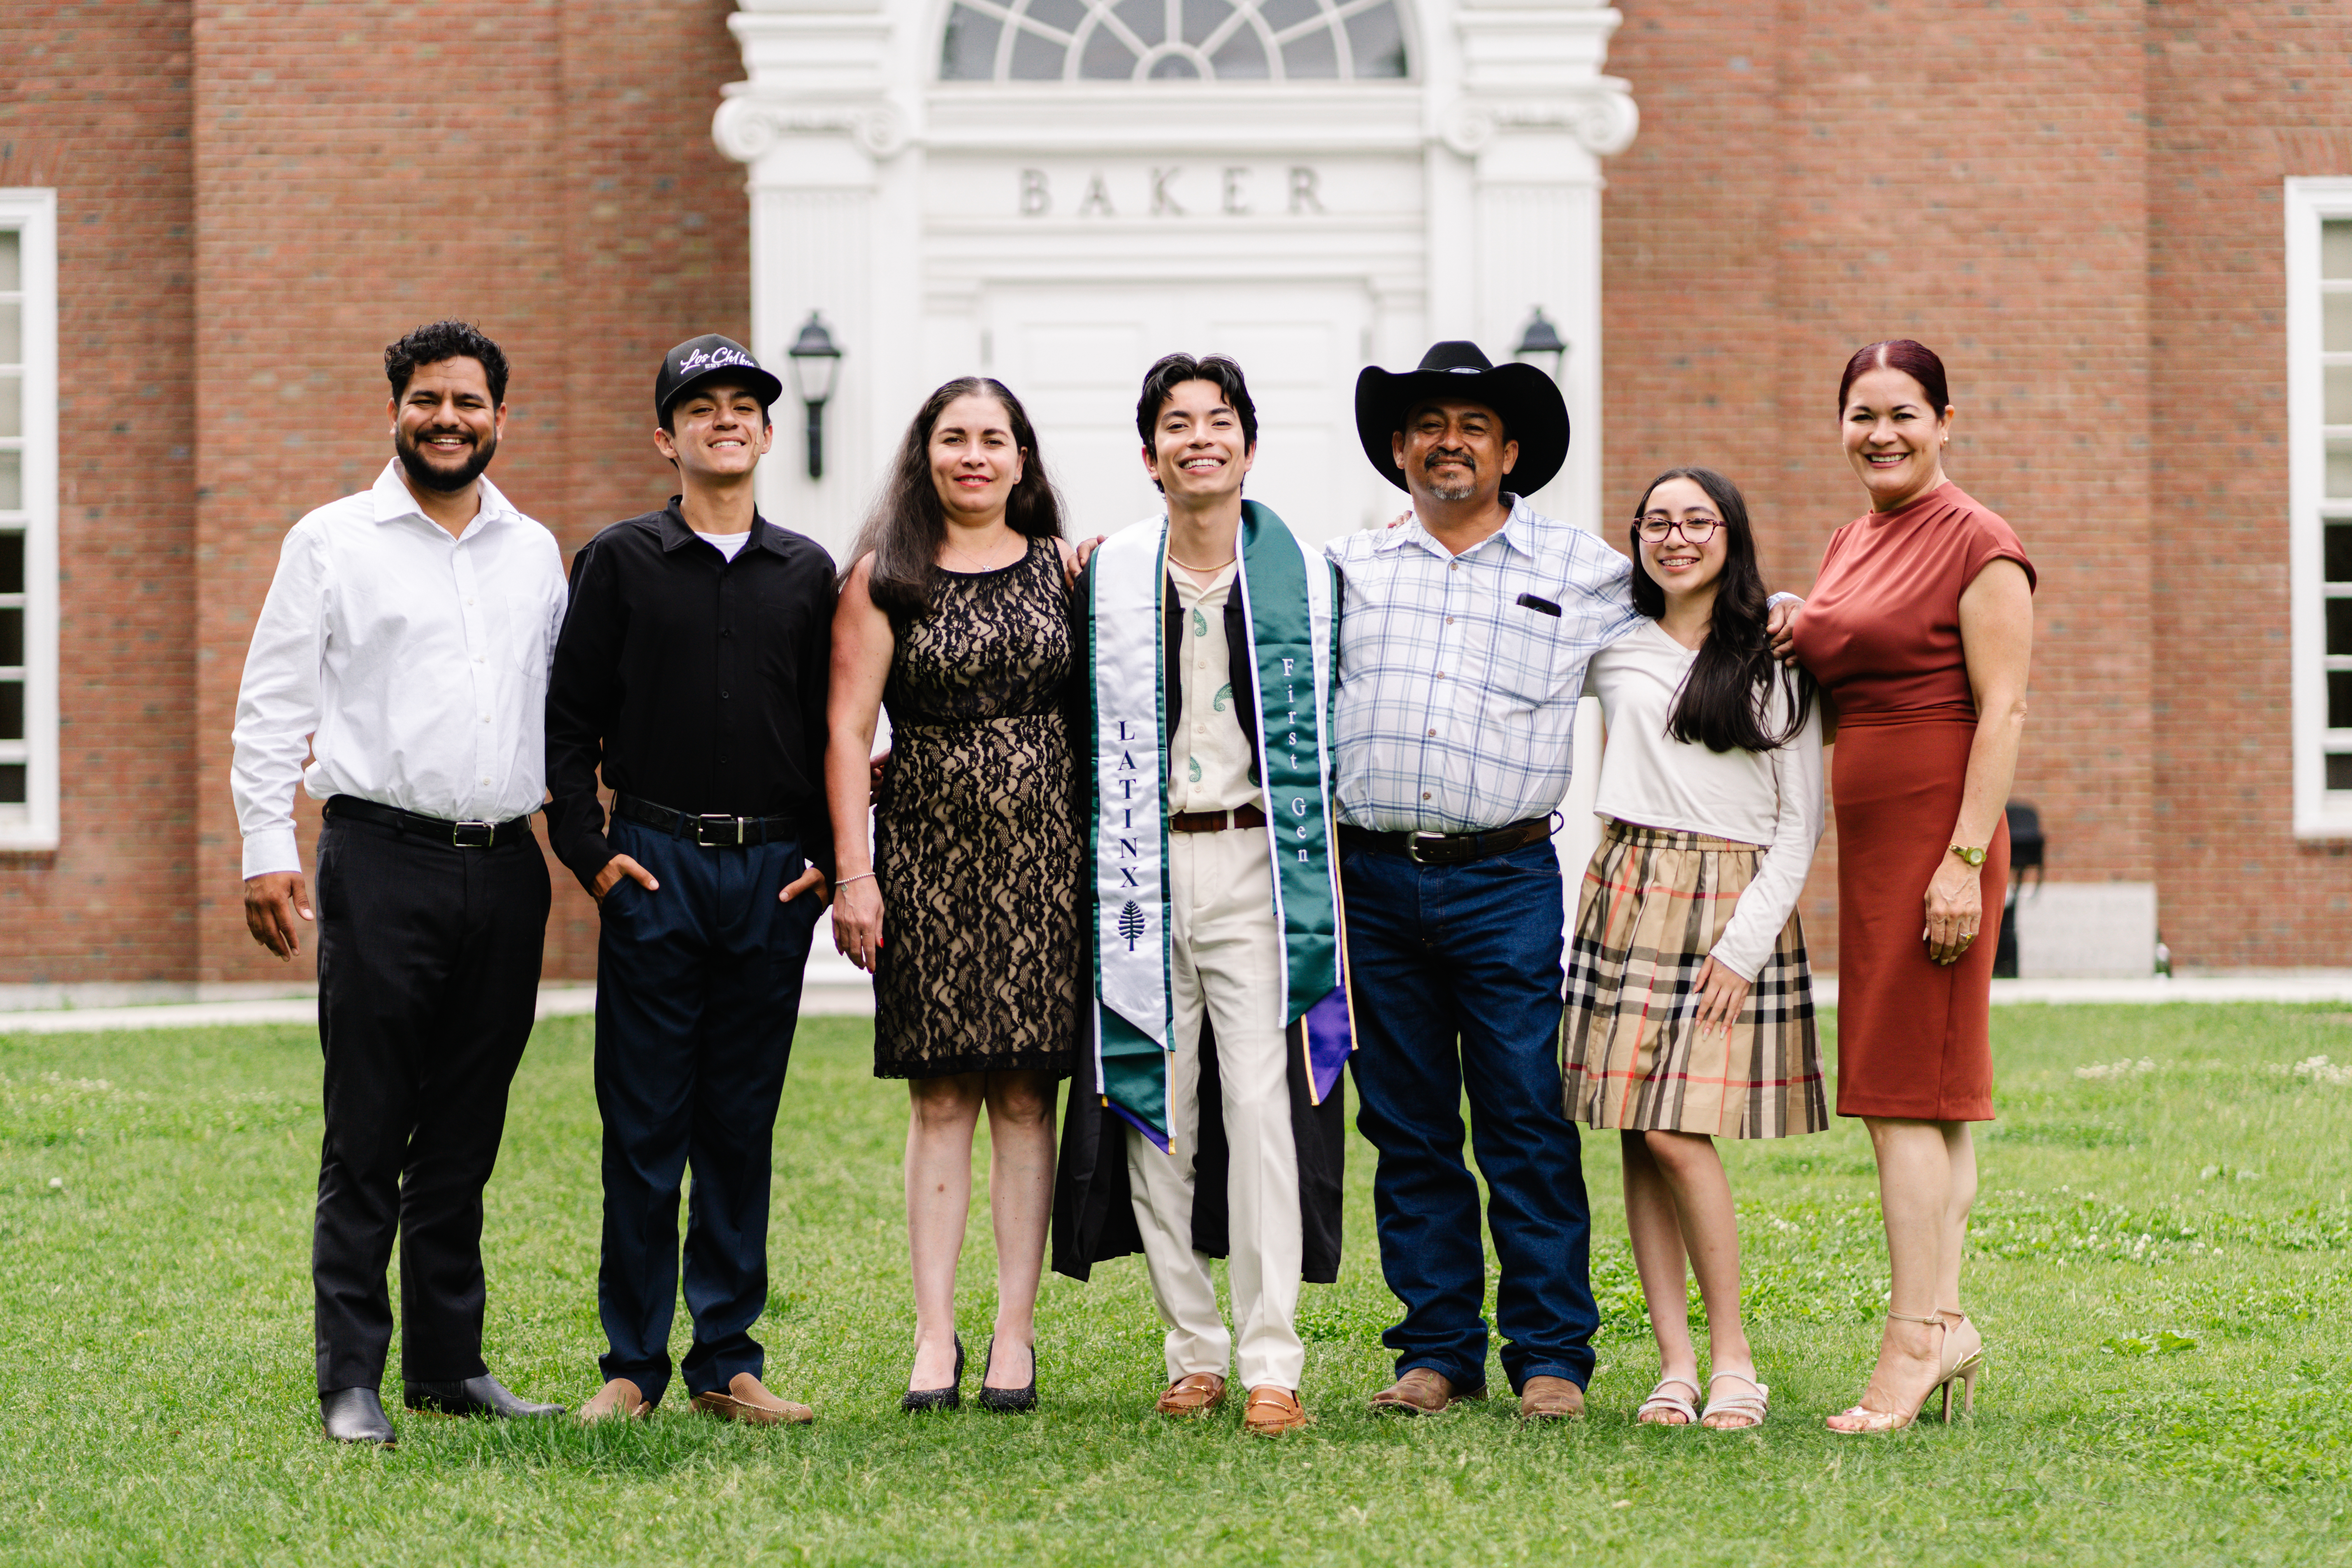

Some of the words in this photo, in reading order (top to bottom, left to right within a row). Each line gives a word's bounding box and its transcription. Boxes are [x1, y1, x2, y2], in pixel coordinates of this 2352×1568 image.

[1019, 166, 1327, 217] BAKER
[680, 348, 710, 374] Los
[1117, 720, 1140, 888] LATINX
[1282, 658, 1298, 770] First
[1292, 797, 1309, 862] Gen
